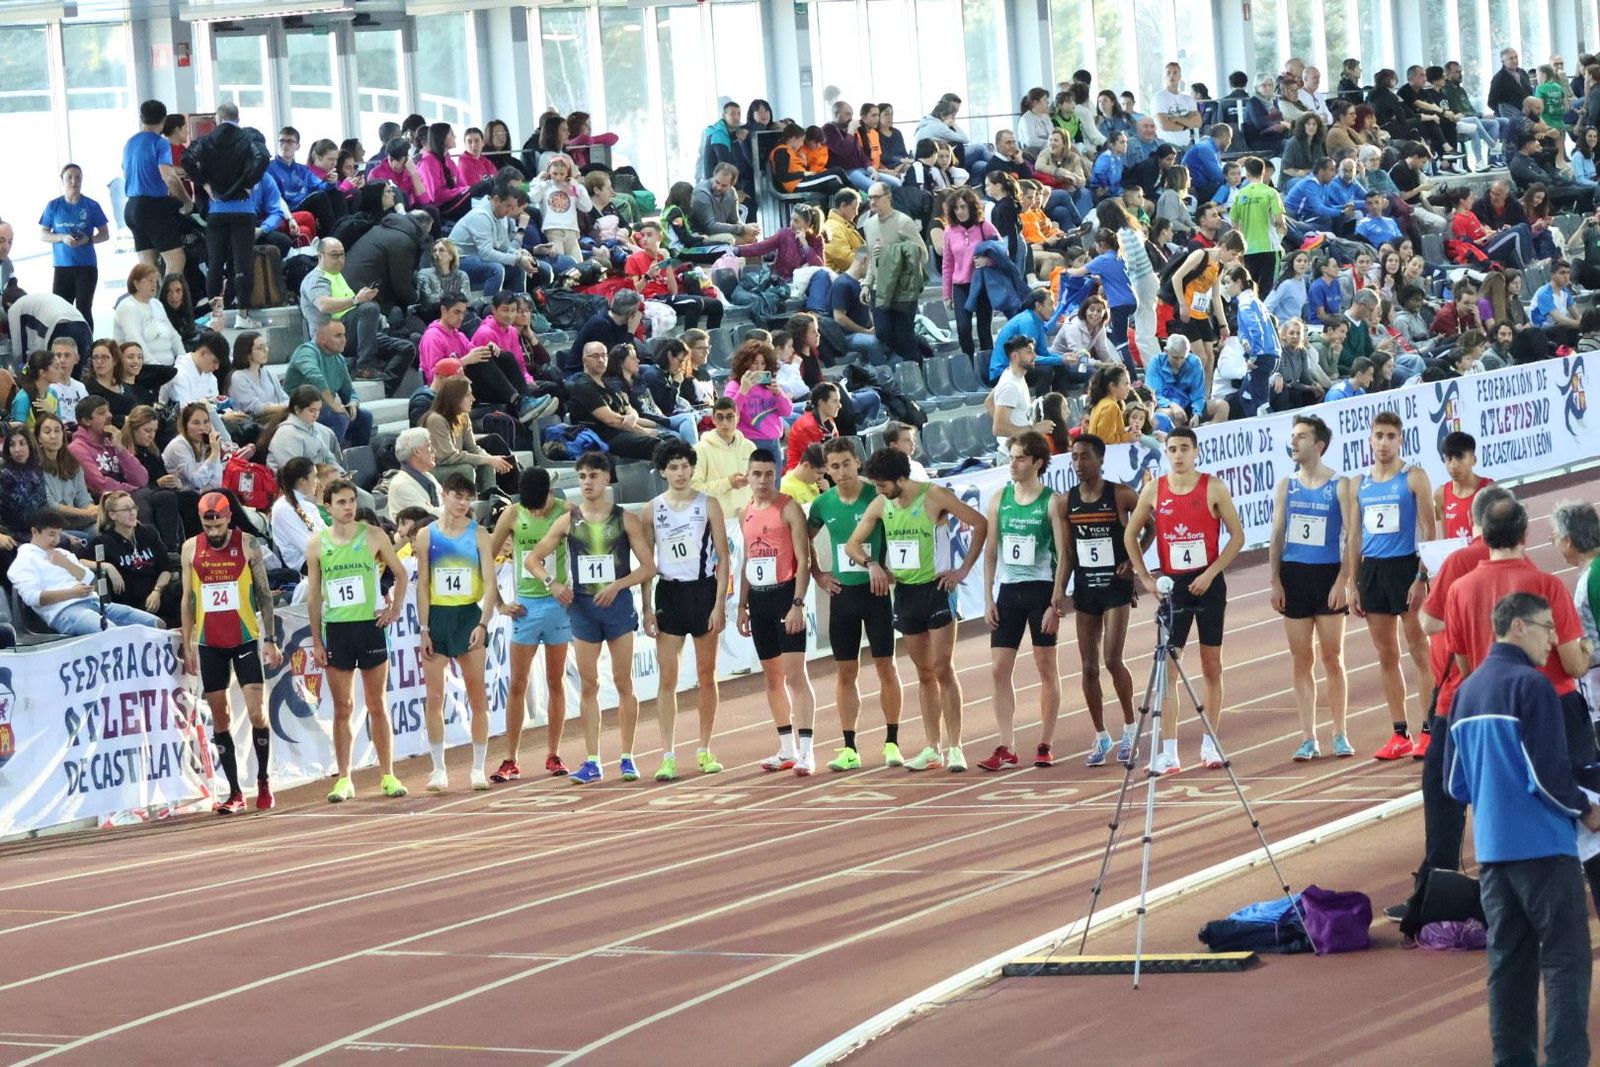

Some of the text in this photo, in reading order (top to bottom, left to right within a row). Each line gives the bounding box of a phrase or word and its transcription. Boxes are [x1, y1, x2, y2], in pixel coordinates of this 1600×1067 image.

[1476, 367, 1548, 403] FEDERACIÓN DE
[1405, 394, 1418, 420] DE
[1480, 397, 1550, 438] ATLETISMO
[1258, 427, 1274, 454] DE
[1482, 443, 1493, 468] DE
[1492, 437, 1528, 465] CASTILLA
[1532, 427, 1553, 457] LEÓN
[1376, 512, 1385, 529] 2
[1302, 523, 1311, 540] 3
[671, 542, 688, 559] 10
[900, 548, 907, 564] 7
[1012, 543, 1020, 560] 6
[1090, 547, 1099, 562] 5
[1183, 548, 1192, 564] 4
[588, 561, 604, 579] 11
[756, 565, 764, 581] 9
[445, 575, 461, 591] 14
[212, 590, 229, 607] 24
[338, 585, 354, 601] 15
[64, 757, 89, 797] DE
[800, 790, 897, 804] 4
[976, 787, 1080, 801] 3
